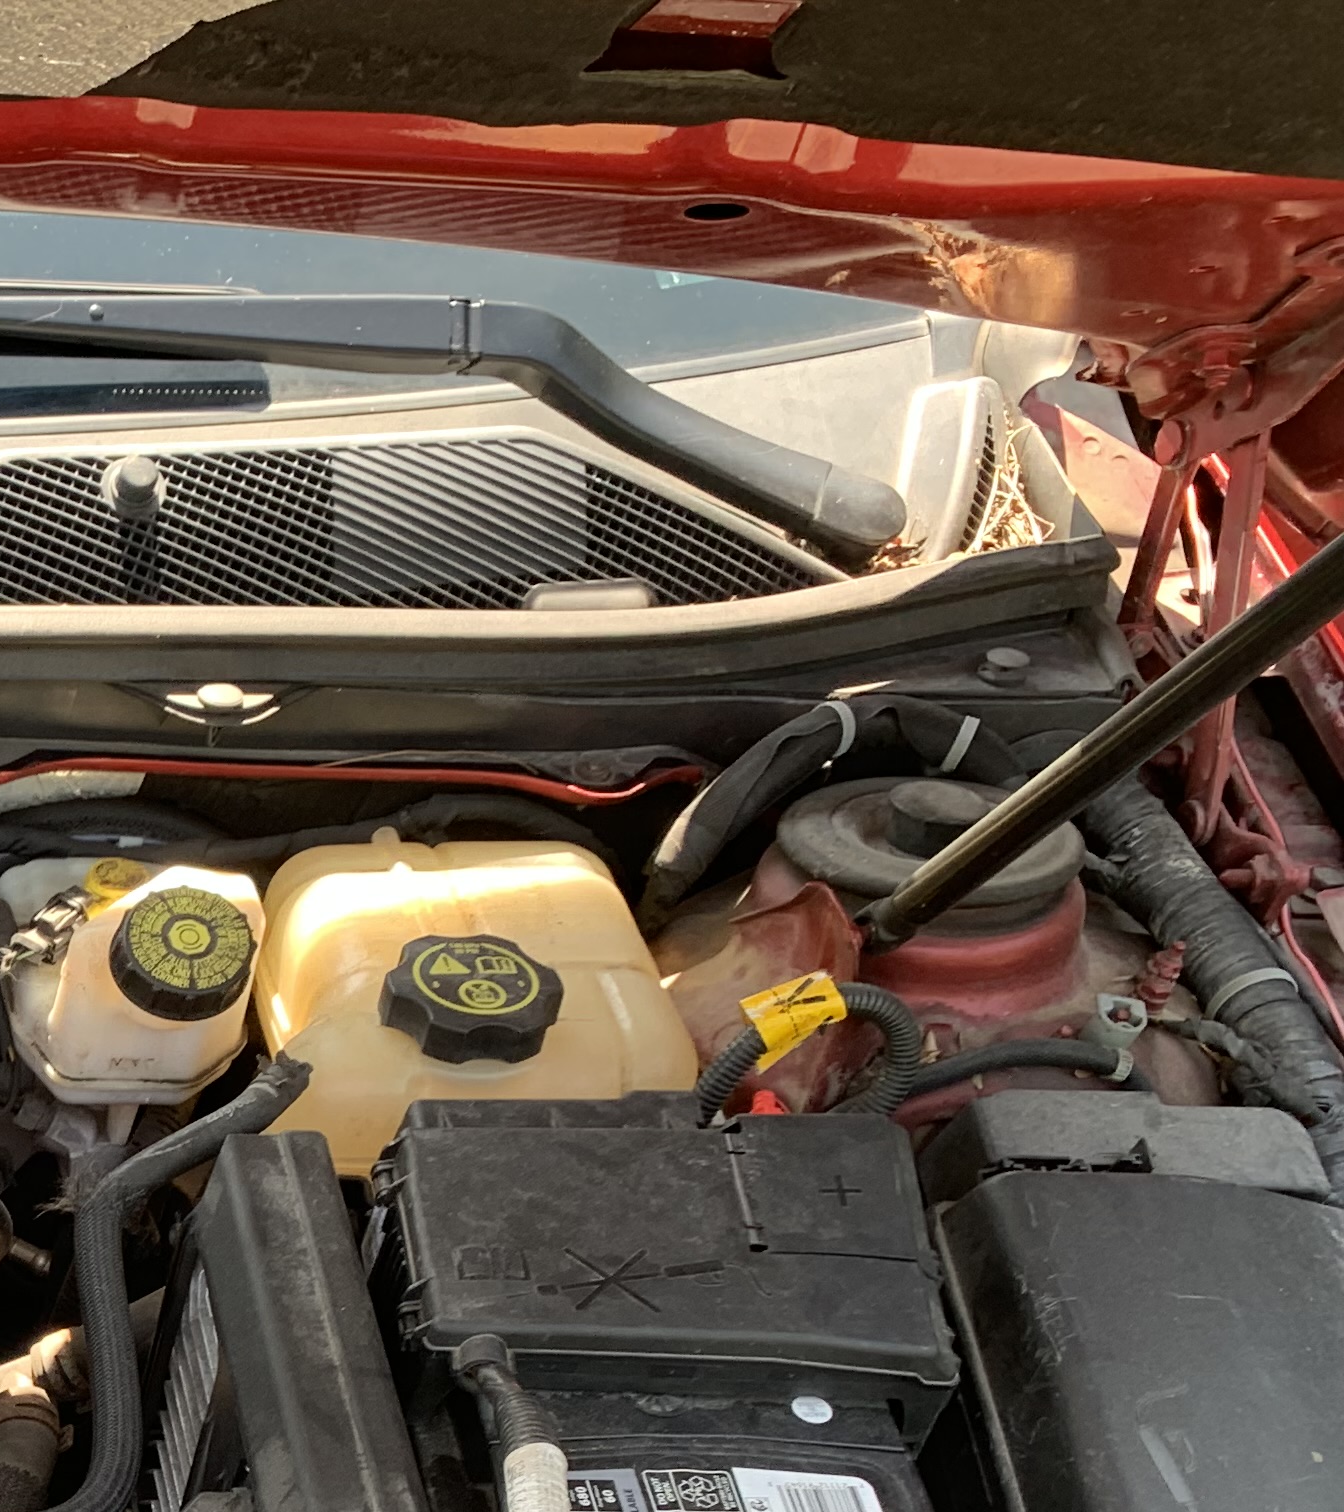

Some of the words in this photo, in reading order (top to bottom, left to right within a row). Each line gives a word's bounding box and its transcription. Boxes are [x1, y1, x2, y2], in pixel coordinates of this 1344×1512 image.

[649, 1477, 664, 1492] NOT
[573, 1485, 592, 1506] 680
[599, 1489, 617, 1503] 60
[654, 1492, 668, 1505] DO
